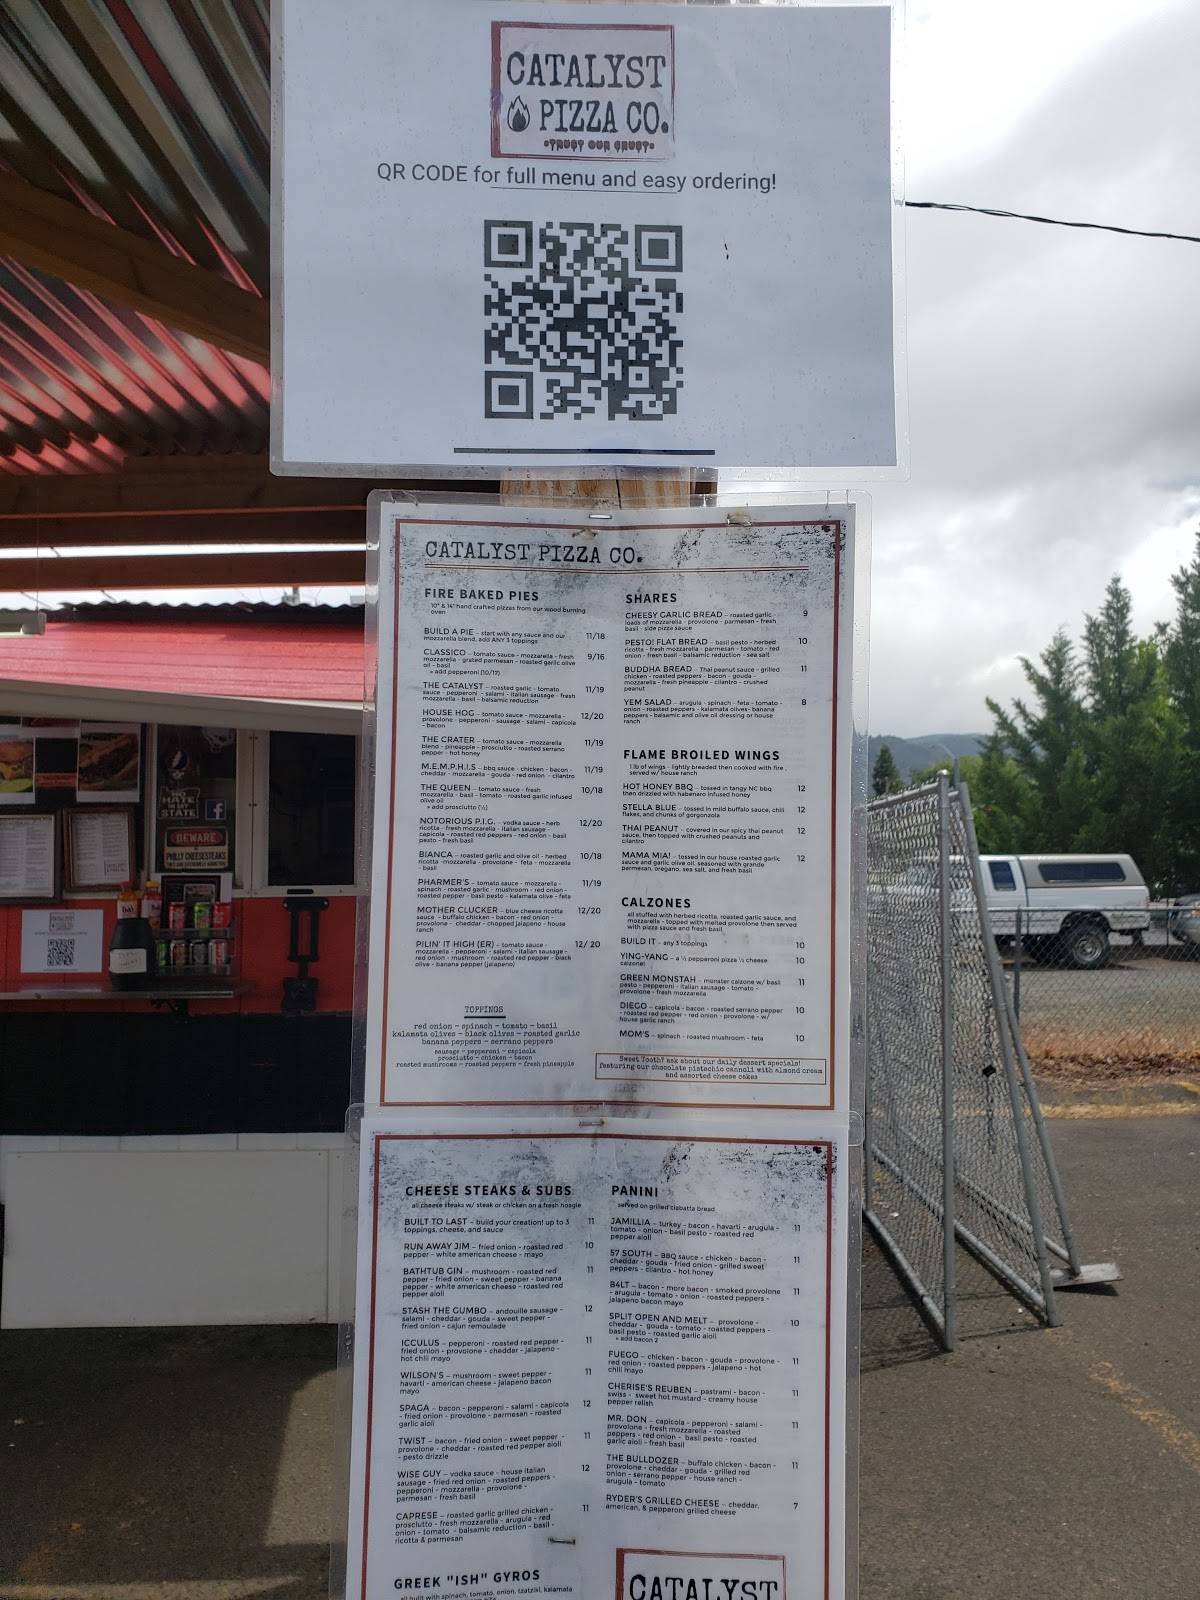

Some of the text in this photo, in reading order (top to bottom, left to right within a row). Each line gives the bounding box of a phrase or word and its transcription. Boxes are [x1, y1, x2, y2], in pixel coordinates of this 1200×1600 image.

[507, 51, 666, 88] CATALYST
[539, 100, 669, 134] PIZZA CO.
[377, 163, 777, 194] QR CODE for full menu and easy ordering!
[425, 541, 643, 564] CATALYST PIZZA CO.
[425, 588, 539, 601] FIRE BAKED PIES
[626, 593, 677, 604] SHARES
[625, 611, 658, 619] CHEESY
[803, 609, 808, 617] 9
[424, 627, 450, 635] BUILD
[460, 628, 474, 636] PIE
[586, 632, 606, 640] 11/18
[423, 648, 466, 656] CLASSICO
[587, 653, 605, 661] 9/16
[663, 665, 692, 673] BREAD
[423, 681, 483, 690] THE CATALYST
[644, 698, 672, 706] SALAD
[801, 698, 807, 706] 8
[455, 709, 475, 717] HOG
[581, 712, 604, 720] 12/20
[422, 735, 475, 744] THE CRATER
[624, 750, 779, 761] FLAME BROILED WINGS
[439, 784, 471, 792] QUEEN
[581, 786, 603, 794] 10/18
[675, 783, 693, 792] BBQ
[622, 803, 653, 811] STELLA
[161, 809, 196, 817] STATE
[420, 817, 473, 825] NOTORIOUS
[176, 833, 217, 843] BEWARE
[418, 878, 470, 886] PHARMER'S
[621, 897, 691, 908] CALZONES
[417, 906, 498, 914] MOTHER CLUCKER
[578, 907, 601, 915] 12/20
[443, 940, 451, 948] IT
[453, 940, 475, 948] HIGH
[621, 937, 646, 945] BUILD
[620, 973, 696, 983] GREEN MONSTAH
[620, 1001, 647, 1010] DIEGO
[619, 1030, 650, 1038] MOM'S
[405, 1185, 571, 1196] CHEESE STEAKS & SUBS
[612, 1185, 658, 1197] PANINI
[404, 1218, 429, 1226] BUILT
[446, 1217, 468, 1225] LAST
[611, 1217, 651, 1226] JAMILLIA
[404, 1242, 470, 1251] RUN AWAY JIM
[610, 1249, 652, 1258] 57 SOUTH
[403, 1267, 463, 1275] BATHTUB GIN
[610, 1280, 630, 1288] B4LT
[402, 1306, 487, 1315] STASH THE GUMBO
[609, 1312, 632, 1320] SPLIT
[635, 1313, 660, 1322] OPEN
[662, 1315, 682, 1323] AND
[684, 1316, 707, 1324] MELT
[790, 1319, 800, 1327] 10
[401, 1339, 440, 1347] ICCULUS
[608, 1350, 639, 1359] FUEGO
[400, 1371, 444, 1379] WILSON'S
[608, 1382, 653, 1392] CHERISE'S
[655, 1385, 692, 1394] REUBEN
[399, 1404, 429, 1412] SPAGA
[626, 1415, 647, 1423] DON
[398, 1437, 426, 1445] TWIST
[607, 1454, 679, 1465] THE BULLDOZER
[397, 1470, 441, 1479] WISE GUY
[606, 1494, 719, 1508] RYDER'S GRILLED CHEESE
[793, 1502, 798, 1510] 7
[396, 1511, 438, 1521] CAPRESE
[394, 1577, 440, 1589] GREEK
[493, 1569, 540, 1583] GYROS
